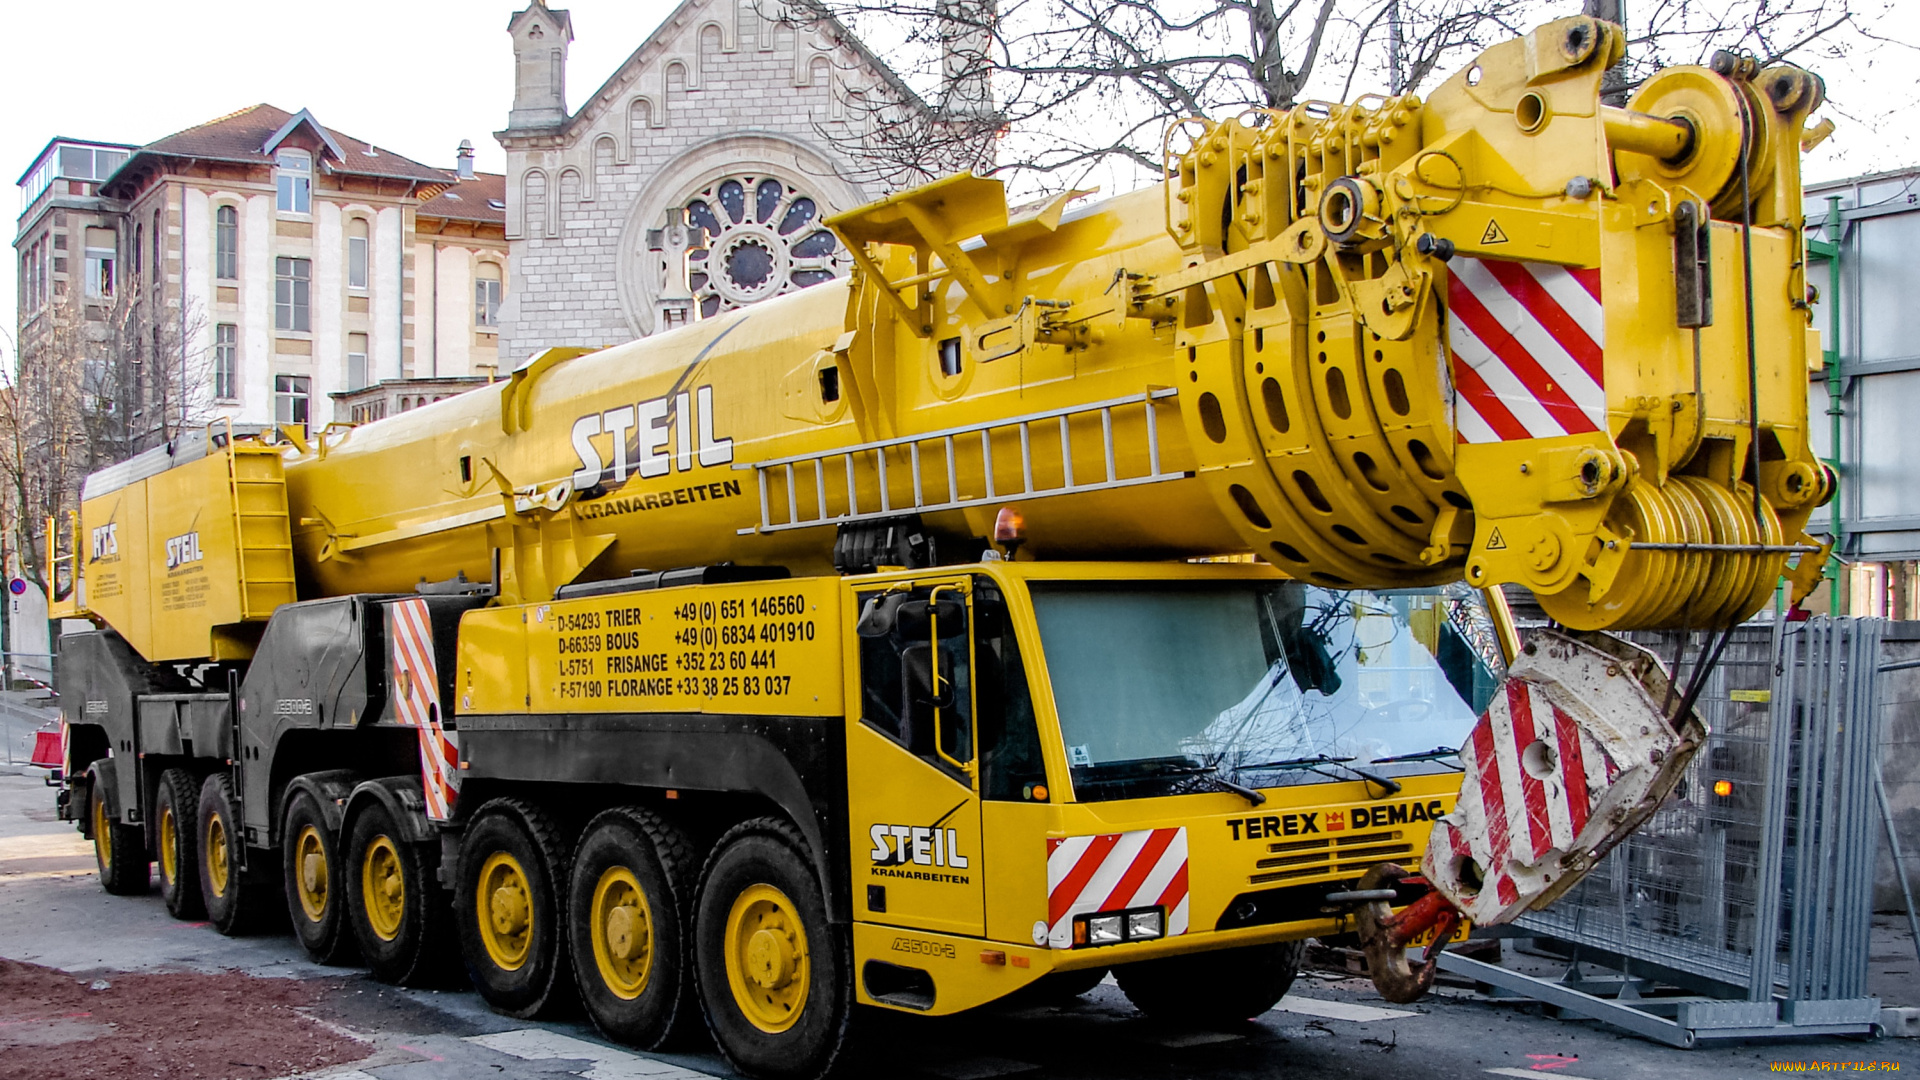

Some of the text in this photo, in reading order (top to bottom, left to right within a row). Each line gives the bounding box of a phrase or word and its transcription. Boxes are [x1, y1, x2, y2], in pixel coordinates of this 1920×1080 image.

[571, 384, 733, 491] STEIL
[573, 480, 742, 520] KRANARBEITEN
[166, 531, 204, 570] STEIL
[557, 594, 805, 632] D-54293 TRIER +49 (0) 651 146560
[558, 621, 815, 654] D-66359 BOUS +49 (0) 6834 401910
[559, 649, 777, 676] L-5751 FRISANGE +352 23 60 441
[560, 675, 791, 698] F-57190 FLORANGE +33 38 25 83 037
[1226, 800, 1446, 841] TEREX DEMAG
[869, 823, 968, 869] STEIL
[871, 867, 969, 885] KRANARBEITEN
